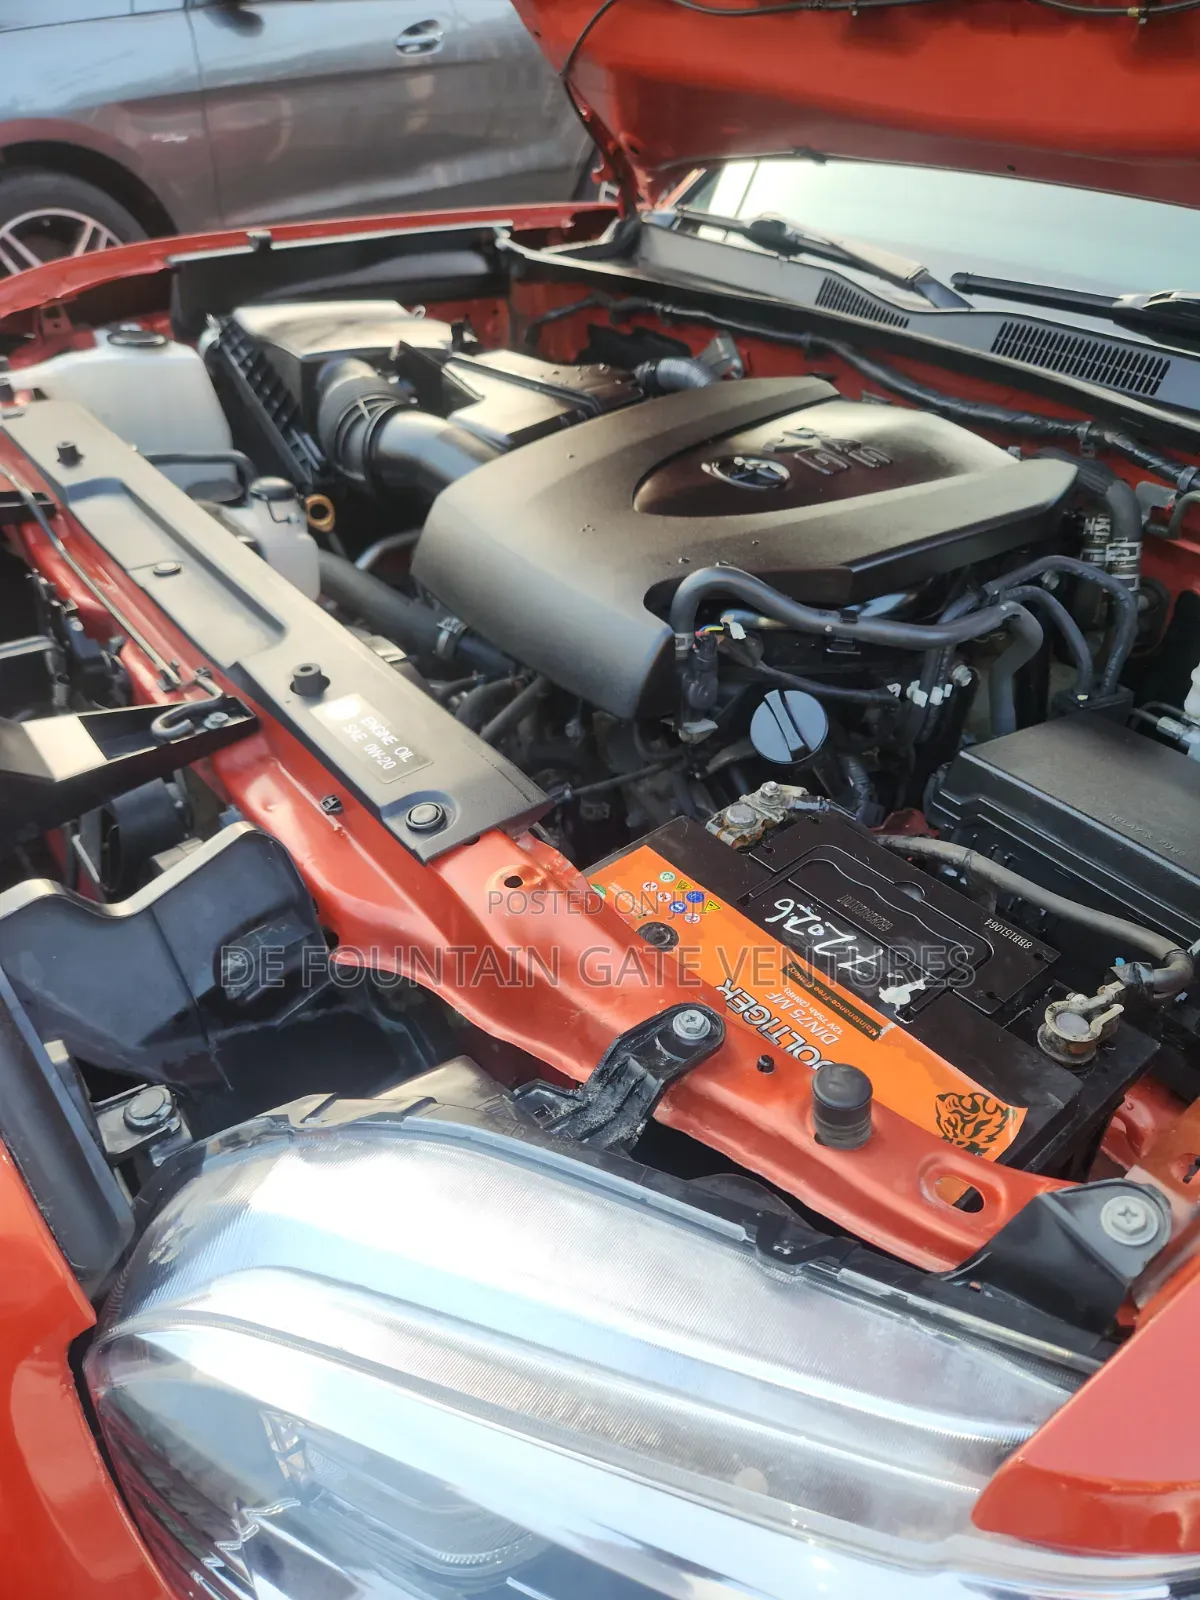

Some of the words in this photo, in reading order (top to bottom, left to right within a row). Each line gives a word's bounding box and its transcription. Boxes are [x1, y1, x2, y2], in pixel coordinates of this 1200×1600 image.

[342, 724, 368, 743] SAE
[360, 715, 399, 746] ENGINE
[394, 746, 415, 763] OIL
[764, 991, 796, 1011] MF
[788, 1009, 839, 1046] DIN75
